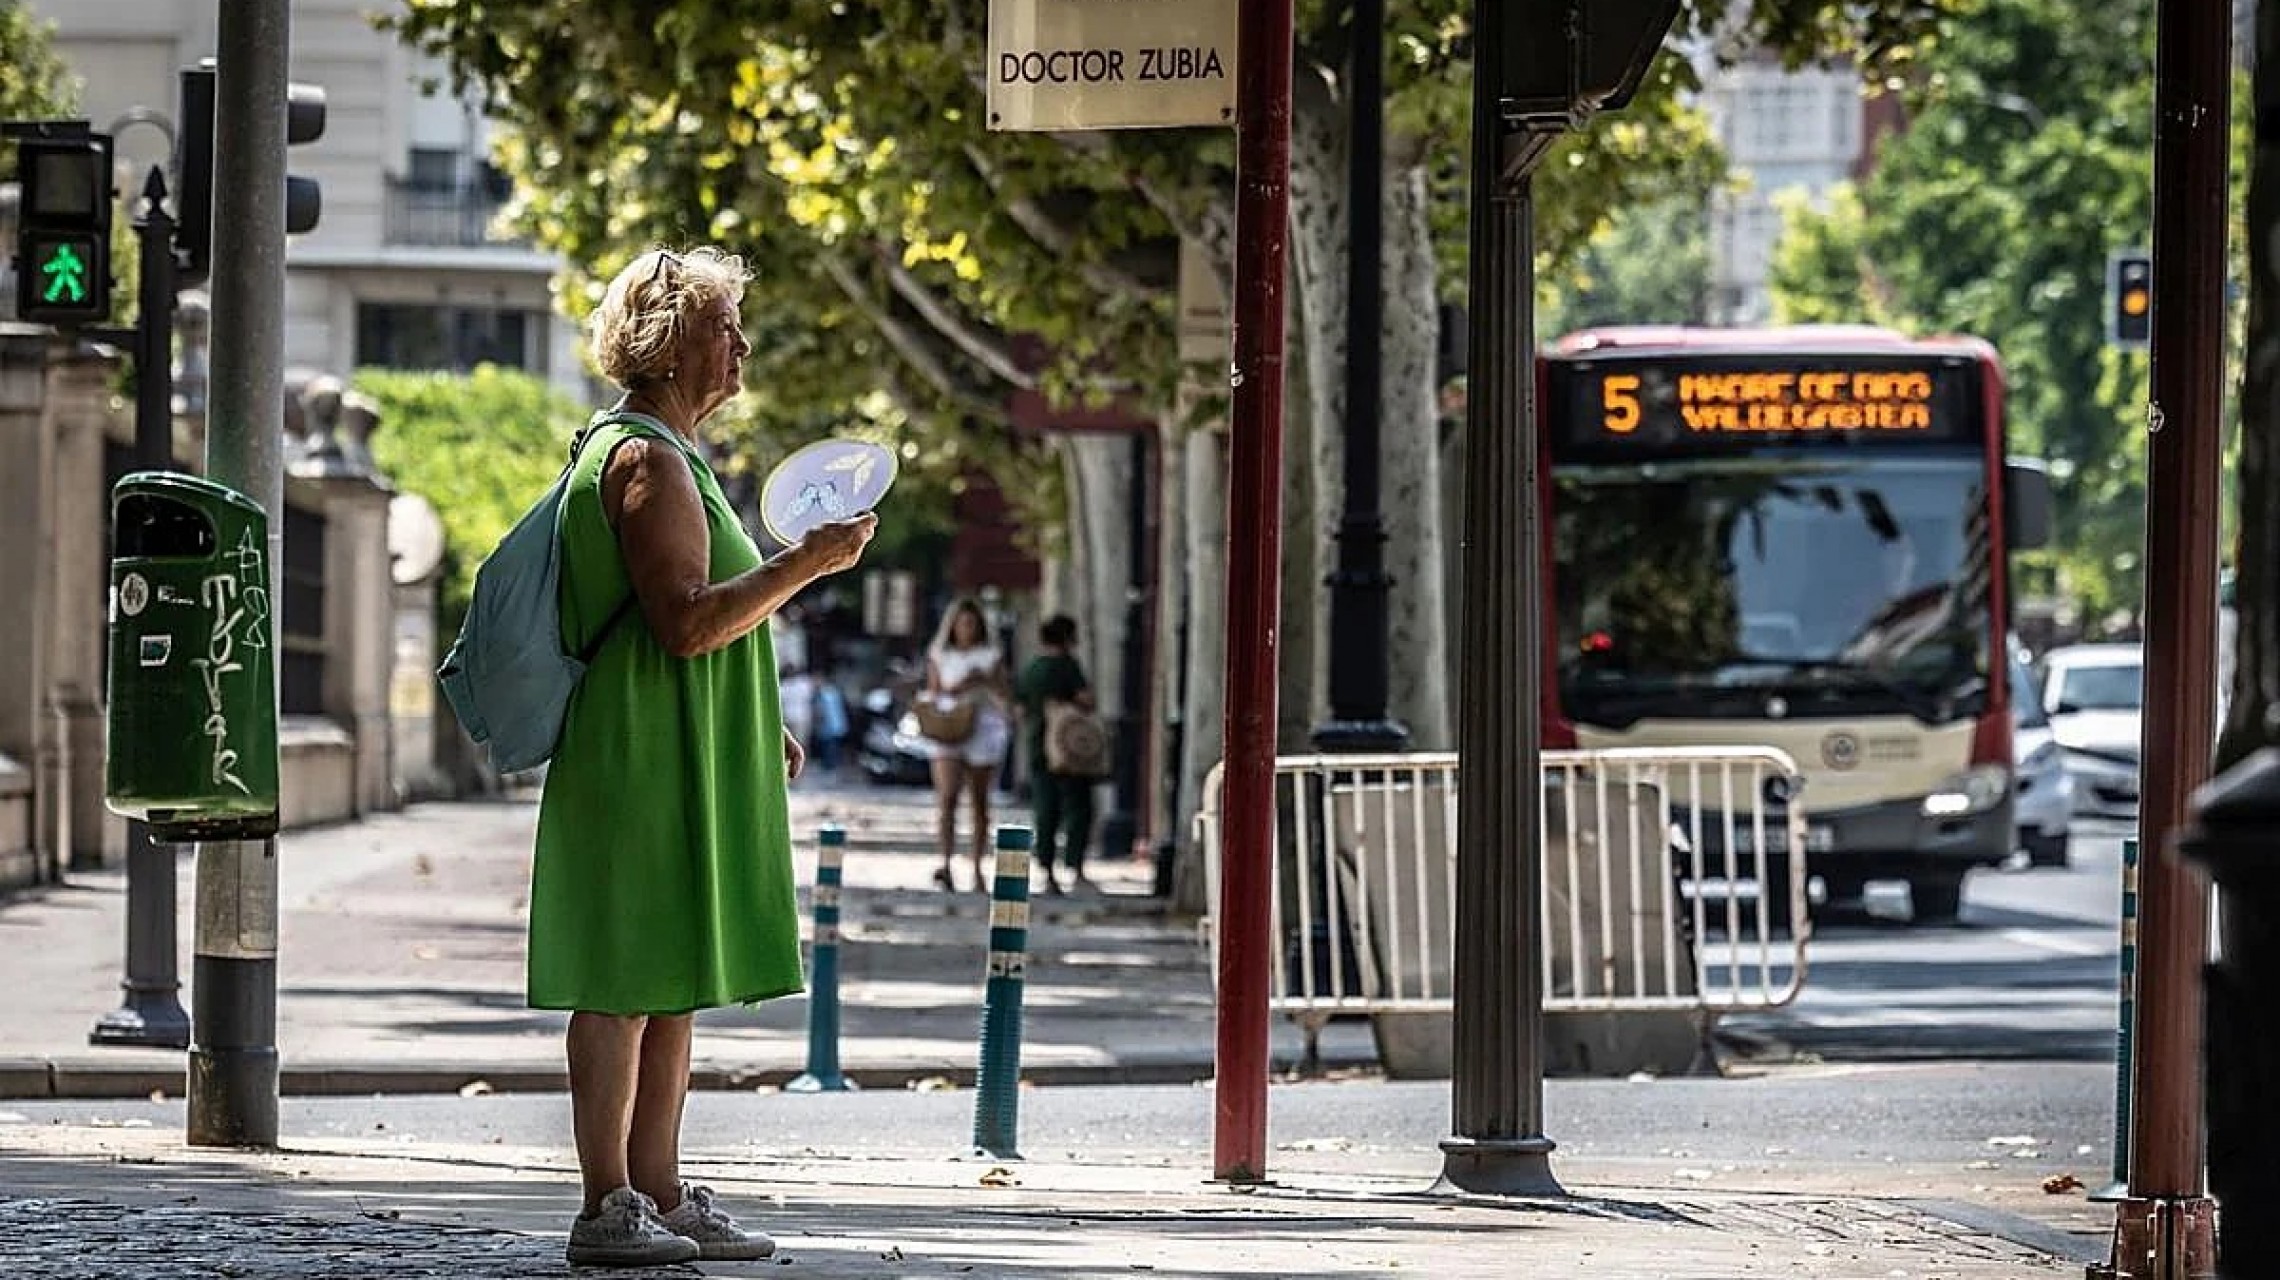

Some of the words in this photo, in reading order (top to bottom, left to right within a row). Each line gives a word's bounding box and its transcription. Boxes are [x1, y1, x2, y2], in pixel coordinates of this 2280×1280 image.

[1001, 50, 1124, 83] DOCTOR
[1139, 47, 1224, 80] ZUBIA
[1603, 375, 1640, 432] 5
